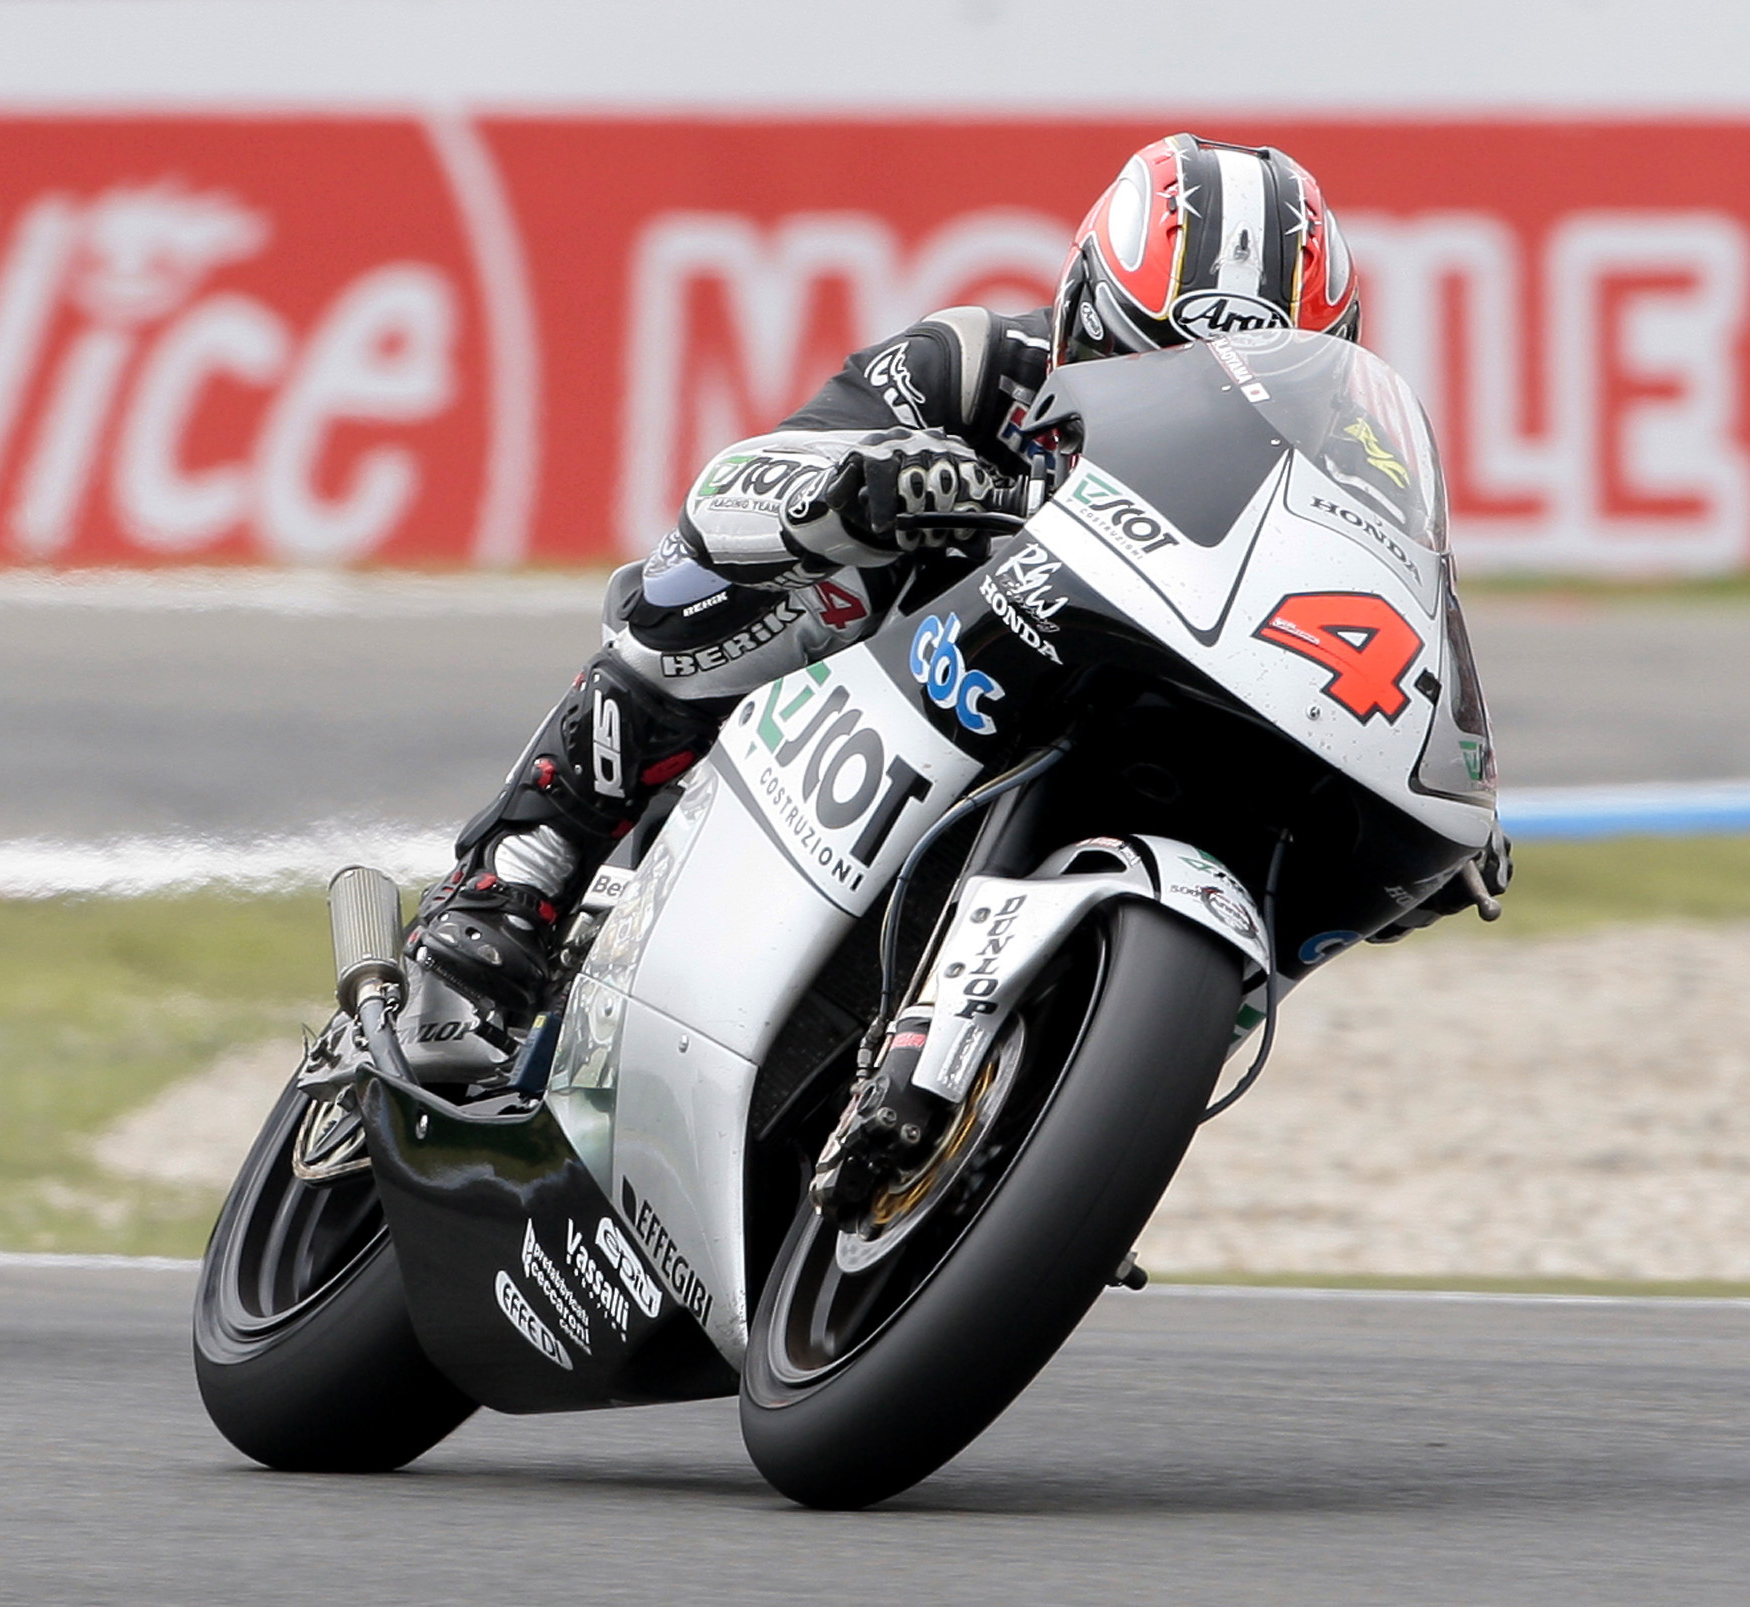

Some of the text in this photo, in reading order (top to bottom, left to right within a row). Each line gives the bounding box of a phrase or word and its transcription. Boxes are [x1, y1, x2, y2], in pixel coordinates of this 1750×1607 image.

[1310, 495, 1422, 586] HONDA
[909, 611, 1006, 736] cbc
[978, 574, 1065, 666] HONDA
[1250, 591, 1425, 727] 4
[759, 766, 865, 892] COSTRUZIONI
[953, 893, 1028, 1020] DUNLOP
[565, 1217, 630, 1332] Vassalli
